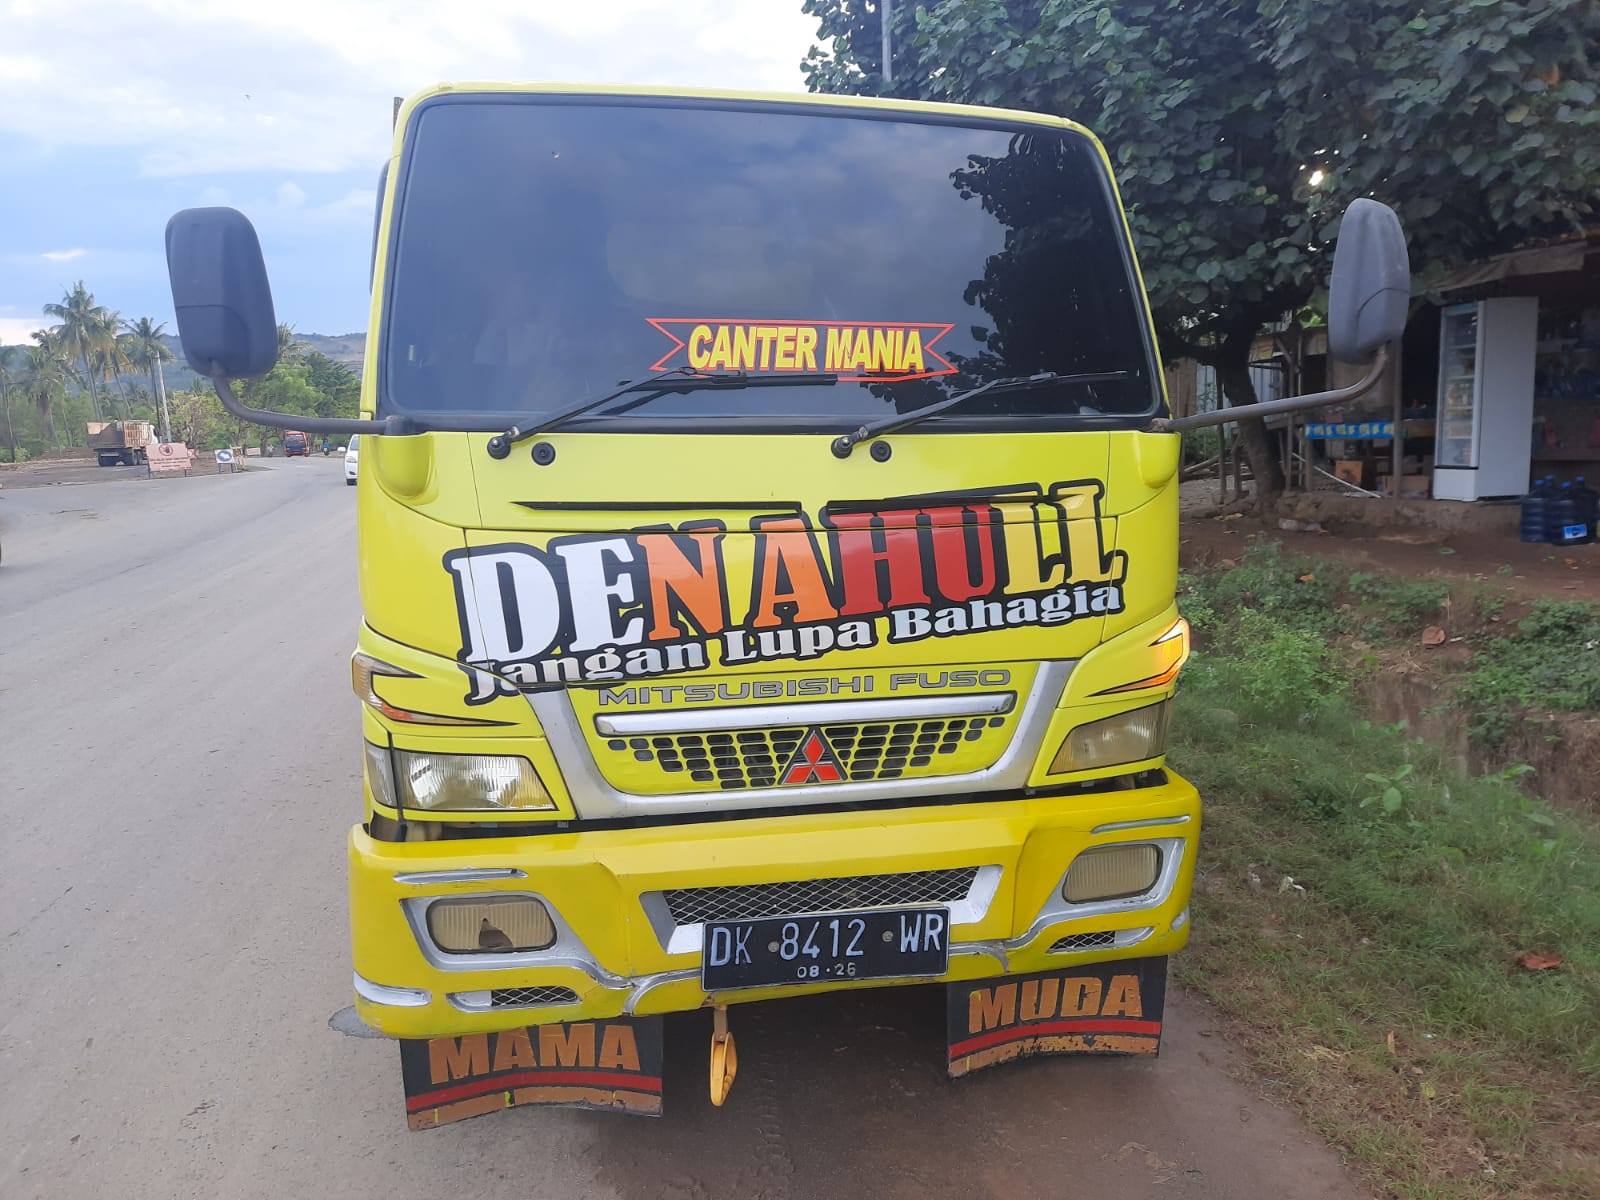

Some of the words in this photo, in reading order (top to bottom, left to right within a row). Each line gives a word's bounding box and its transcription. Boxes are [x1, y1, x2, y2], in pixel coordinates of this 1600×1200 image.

[688, 323, 819, 372] CANTER
[825, 326, 926, 374] MANIA
[445, 481, 1126, 664] DENAHULL
[466, 640, 706, 704] Jangan
[722, 620, 874, 662] Lupa
[889, 583, 1122, 641] Bahagia
[598, 675, 874, 706] MITSUBISHI
[889, 669, 1011, 691] FUSO
[709, 926, 754, 967] DK
[779, 918, 866, 962] 8412
[900, 913, 945, 954] WR
[968, 974, 1143, 1034] MUDA
[428, 1023, 641, 1085] MAMA
